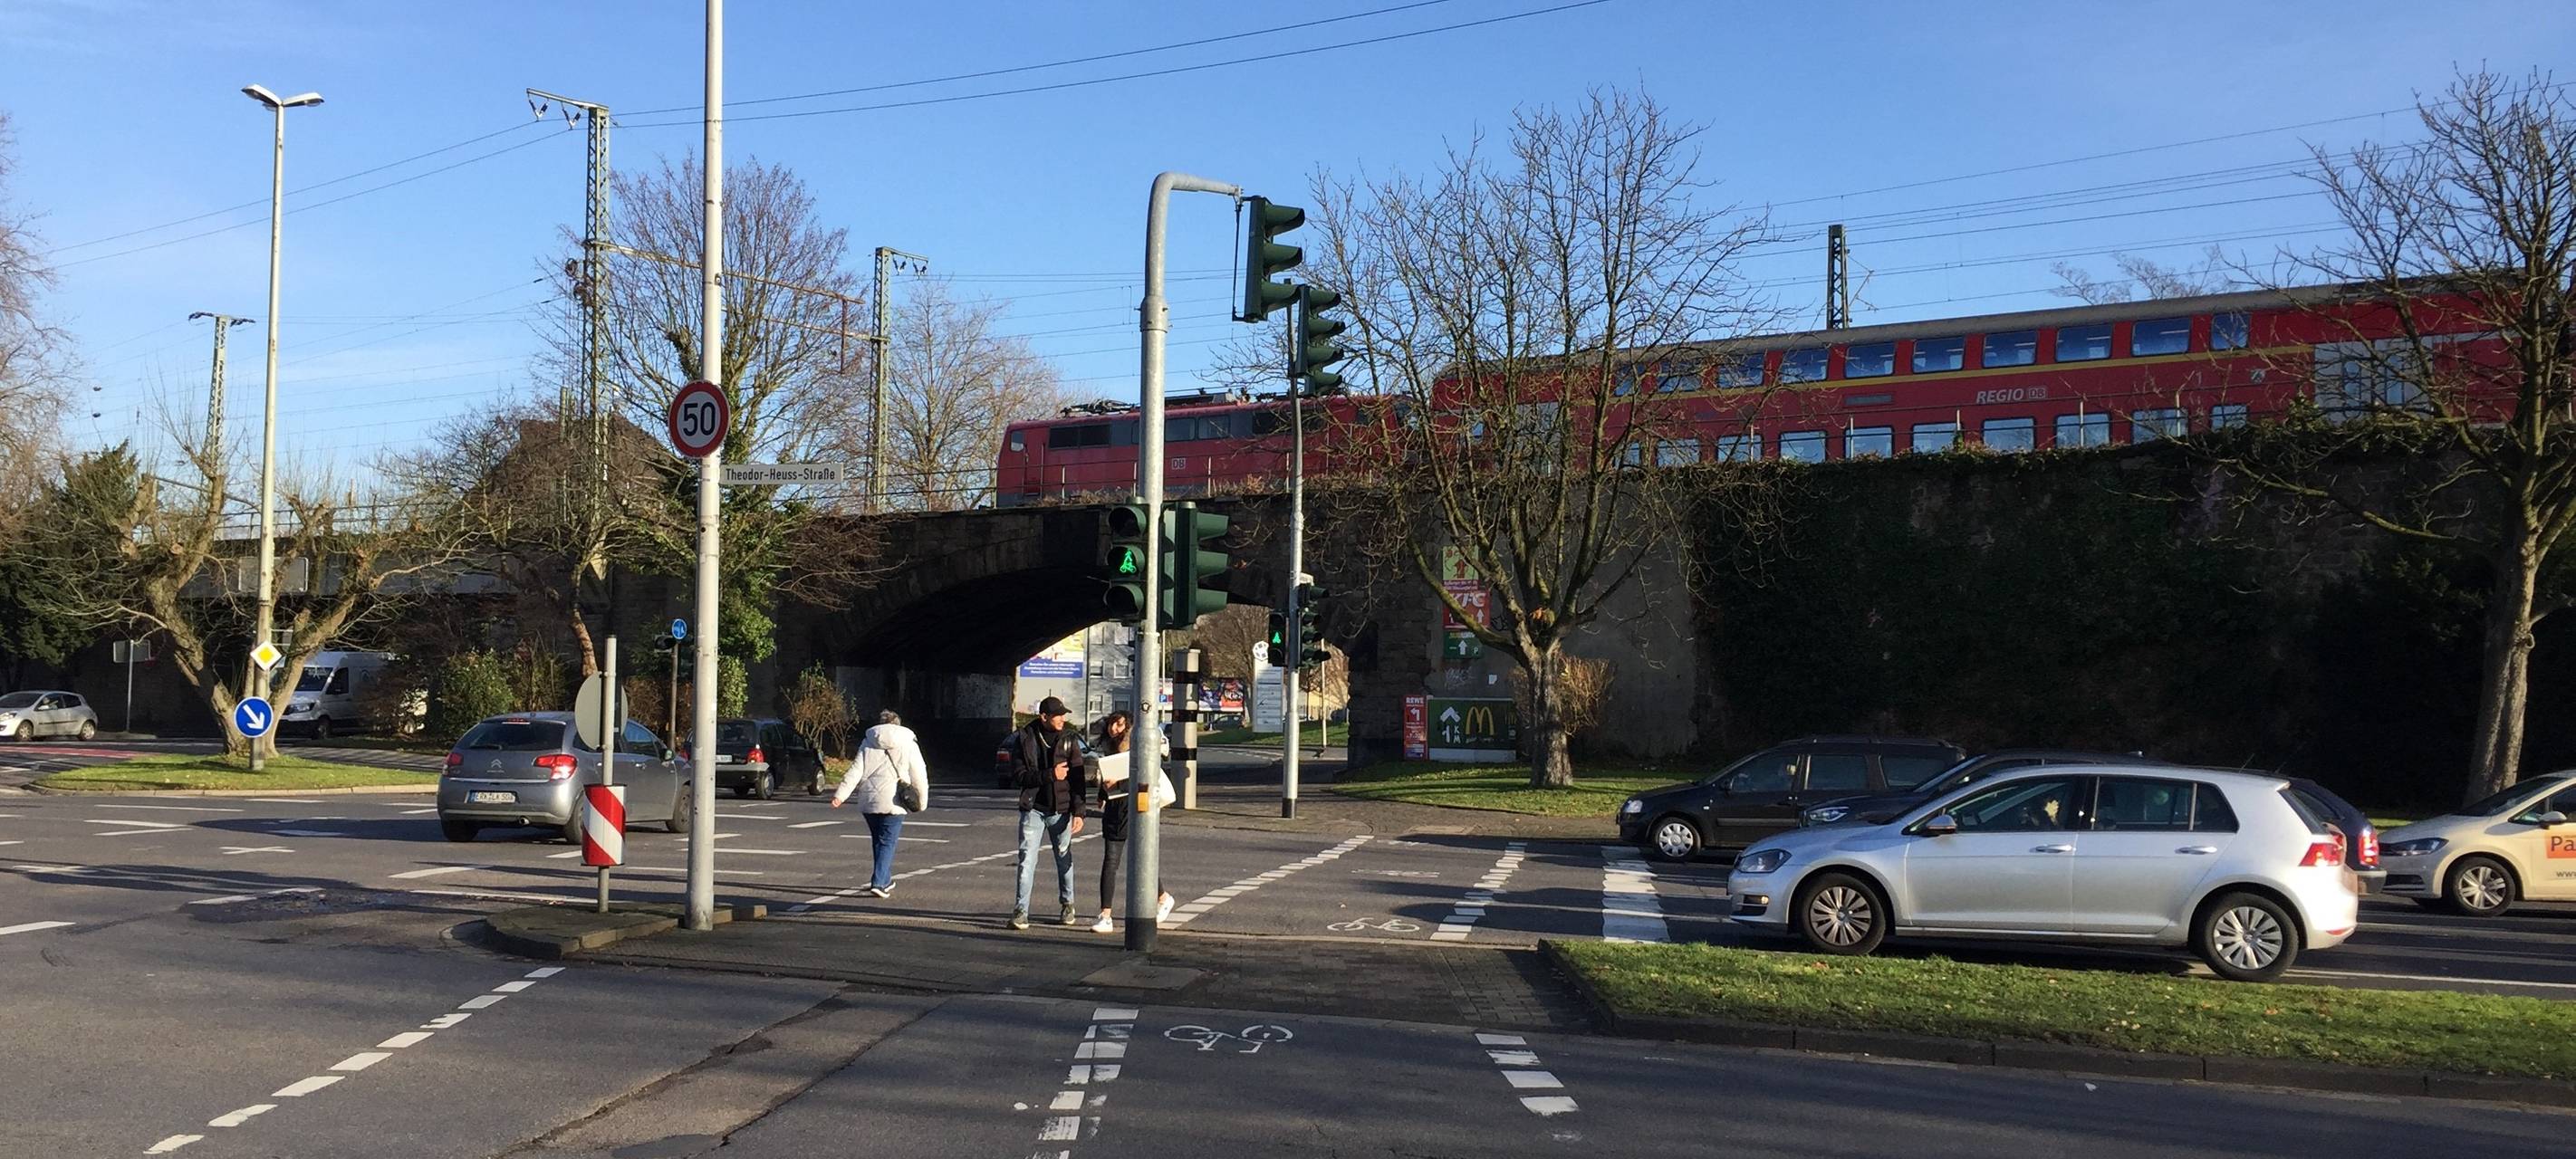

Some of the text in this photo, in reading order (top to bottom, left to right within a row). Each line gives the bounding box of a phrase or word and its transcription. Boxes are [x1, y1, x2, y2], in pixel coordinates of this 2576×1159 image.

[1976, 388, 2024, 404] REGIO
[683, 401, 716, 436] 50
[1172, 457, 1187, 470] DB
[726, 467, 835, 481] Theodor-Heuss-Straße
[2551, 836, 2576, 851] Pa
